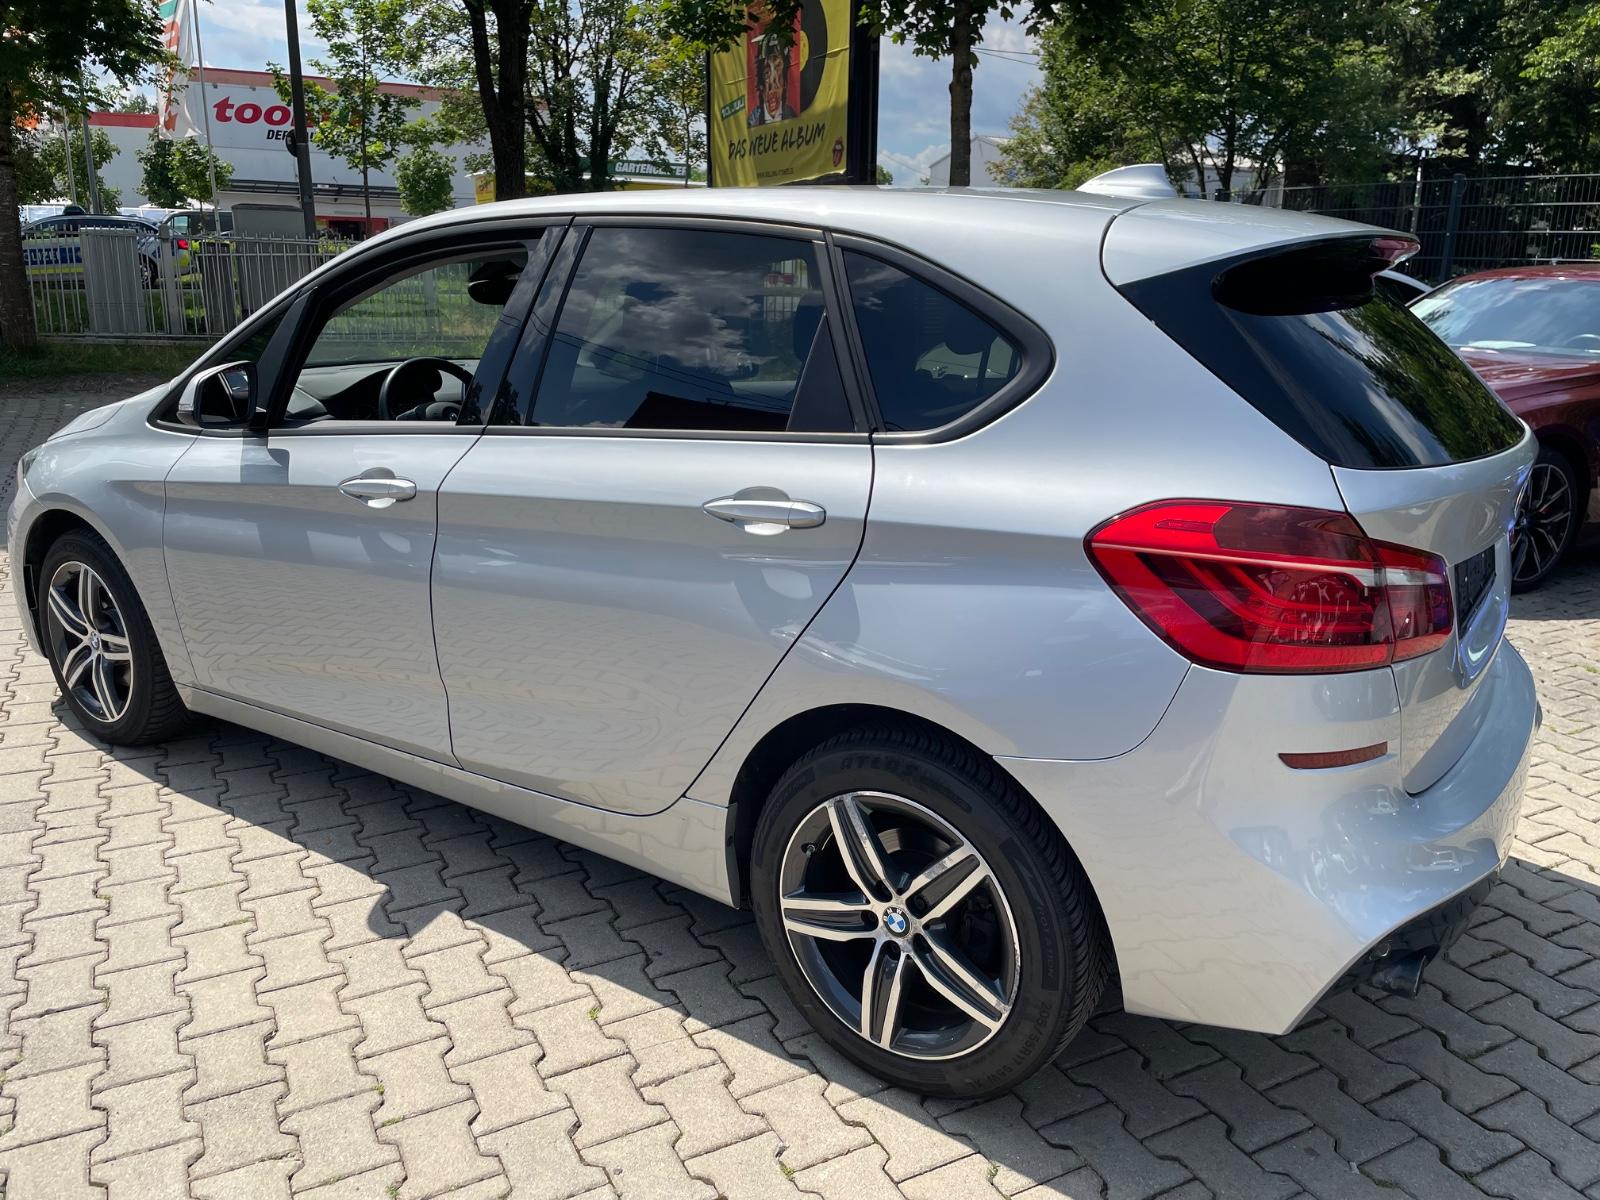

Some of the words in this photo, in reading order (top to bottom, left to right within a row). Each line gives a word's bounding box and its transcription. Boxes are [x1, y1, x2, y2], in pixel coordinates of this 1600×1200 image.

[213, 95, 315, 129] too
[728, 140, 747, 160] DAS
[749, 131, 778, 156] NEUE
[781, 122, 826, 152] ALBUM
